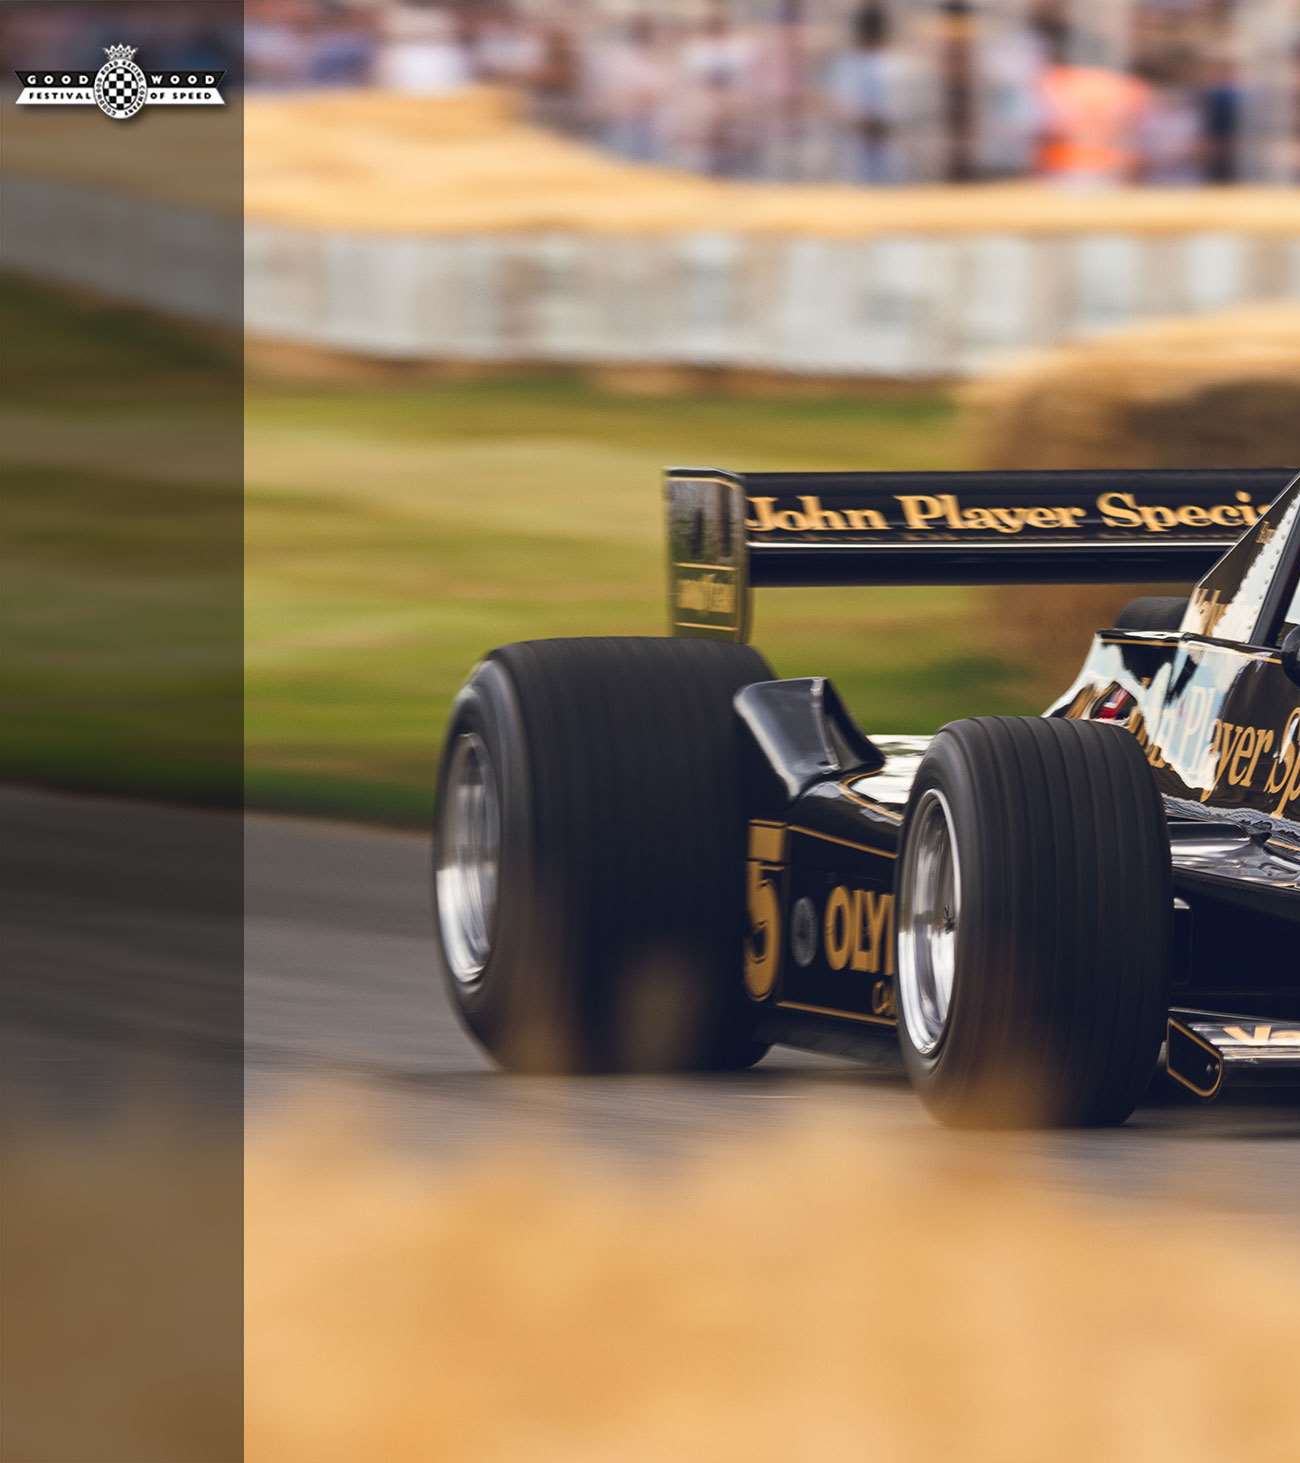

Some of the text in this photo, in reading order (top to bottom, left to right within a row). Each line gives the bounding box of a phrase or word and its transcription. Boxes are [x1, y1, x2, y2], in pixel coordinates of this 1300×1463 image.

[746, 495, 892, 533] John
[894, 493, 1089, 536] Player
[1095, 490, 1271, 533] Speci
[744, 826, 787, 1002] 5
